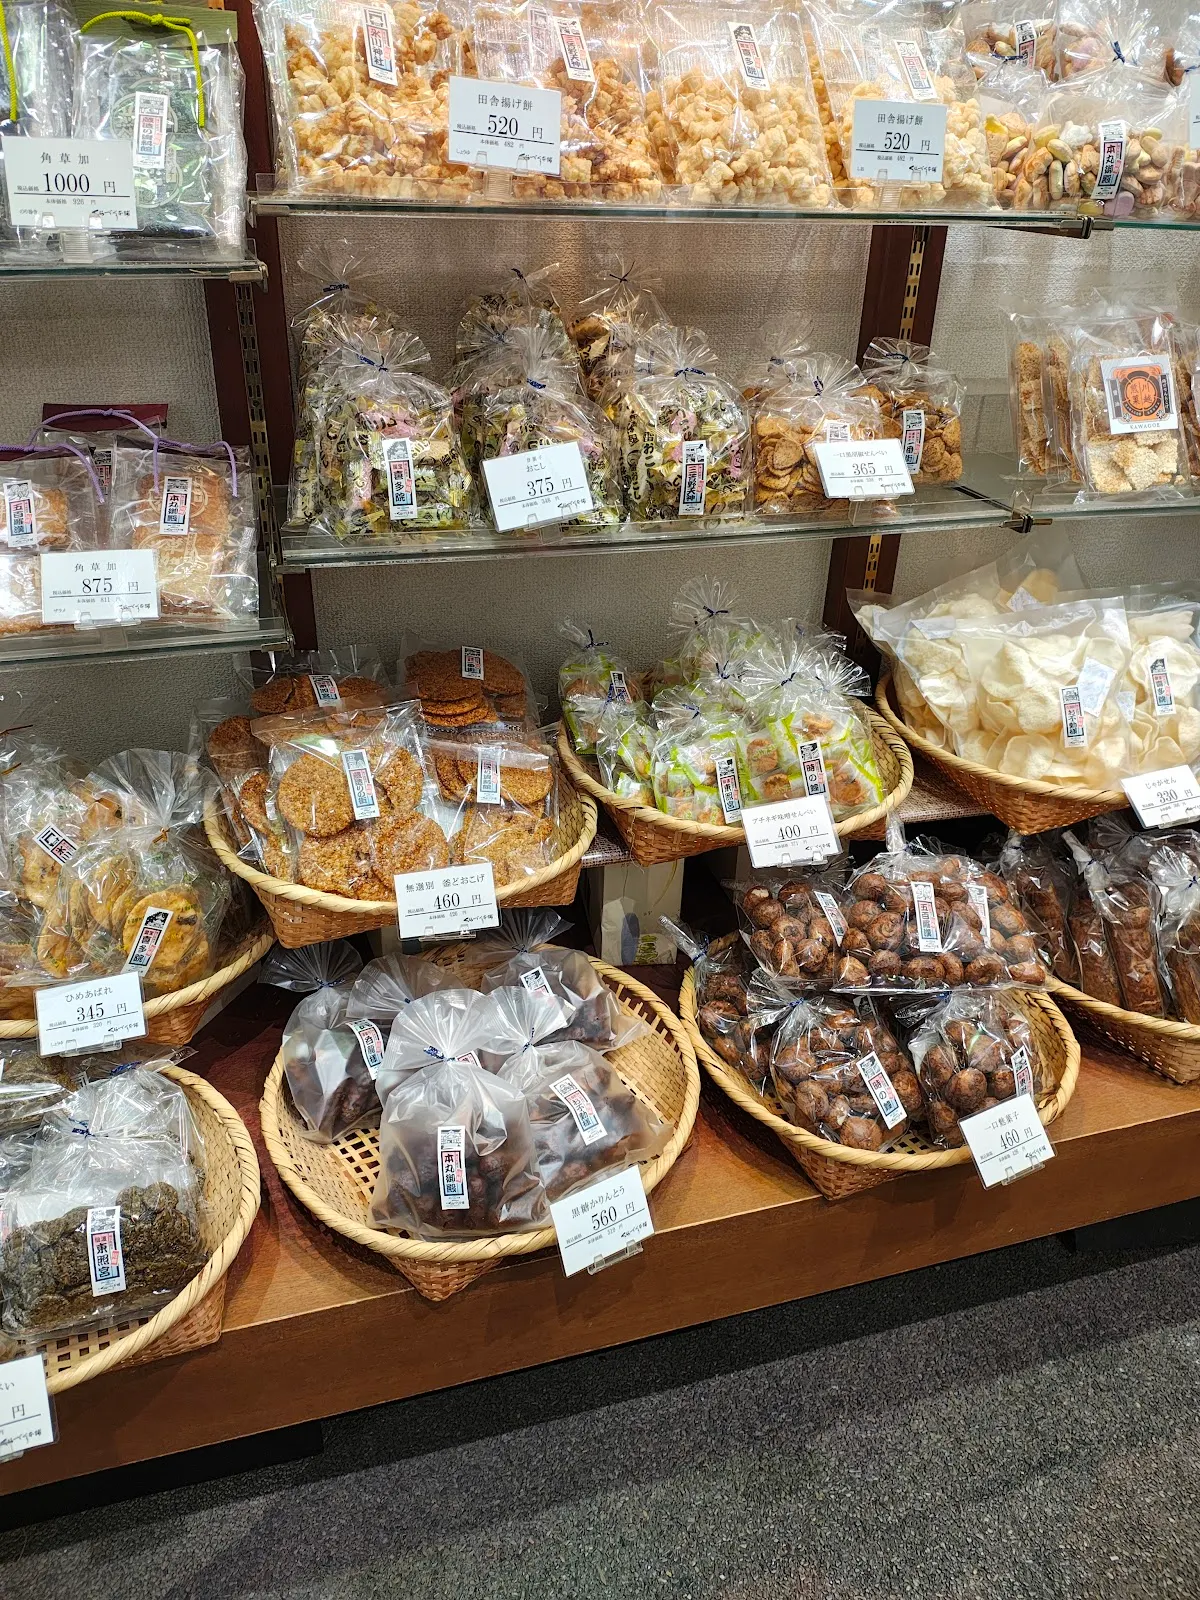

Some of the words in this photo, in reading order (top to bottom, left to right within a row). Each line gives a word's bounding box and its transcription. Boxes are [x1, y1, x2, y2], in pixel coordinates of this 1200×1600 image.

[478, 94, 533, 112] 田舎揚げ餅
[488, 114, 519, 137] 520
[532, 127, 543, 140] 円
[877, 113, 924, 126] 田舎揚げ餅
[884, 132, 910, 151] 520
[920, 139, 931, 152] 円
[42, 172, 90, 193] 1000
[103, 181, 116, 193] 円
[1130, 422, 1161, 430] KAWAGOE
[526, 463, 547, 473] おこし
[852, 463, 876, 476] 365
[885, 466, 894, 474] 円
[393, 470, 406, 502] 喜多院
[526, 476, 554, 498] 375
[561, 478, 573, 490] 円
[82, 578, 113, 594] 875
[128, 581, 139, 592] 円
[1145, 777, 1177, 790] じゃがせん
[1157, 789, 1179, 804] 330
[1184, 789, 1194, 798] 円
[777, 825, 801, 840] 400
[809, 825, 819, 834] 円
[406, 881, 435, 893] 無選別
[433, 892, 461, 910] 460
[471, 894, 482, 905] 円
[132, 935, 152, 963] 喜多院
[76, 1002, 105, 1022] 345
[116, 1003, 127, 1014] 円
[872, 1079, 893, 1111] 時の鐘
[1000, 1129, 1021, 1150] 460
[1023, 1127, 1034, 1139] 円
[444, 1153, 457, 1194] 本丸御殿
[571, 1185, 625, 1219] 黒糖かりんとう
[591, 1206, 617, 1231] 560
[625, 1202, 635, 1215] 円
[97, 1243, 111, 1278] 東照宮
[12, 1403, 26, 1420] 円
